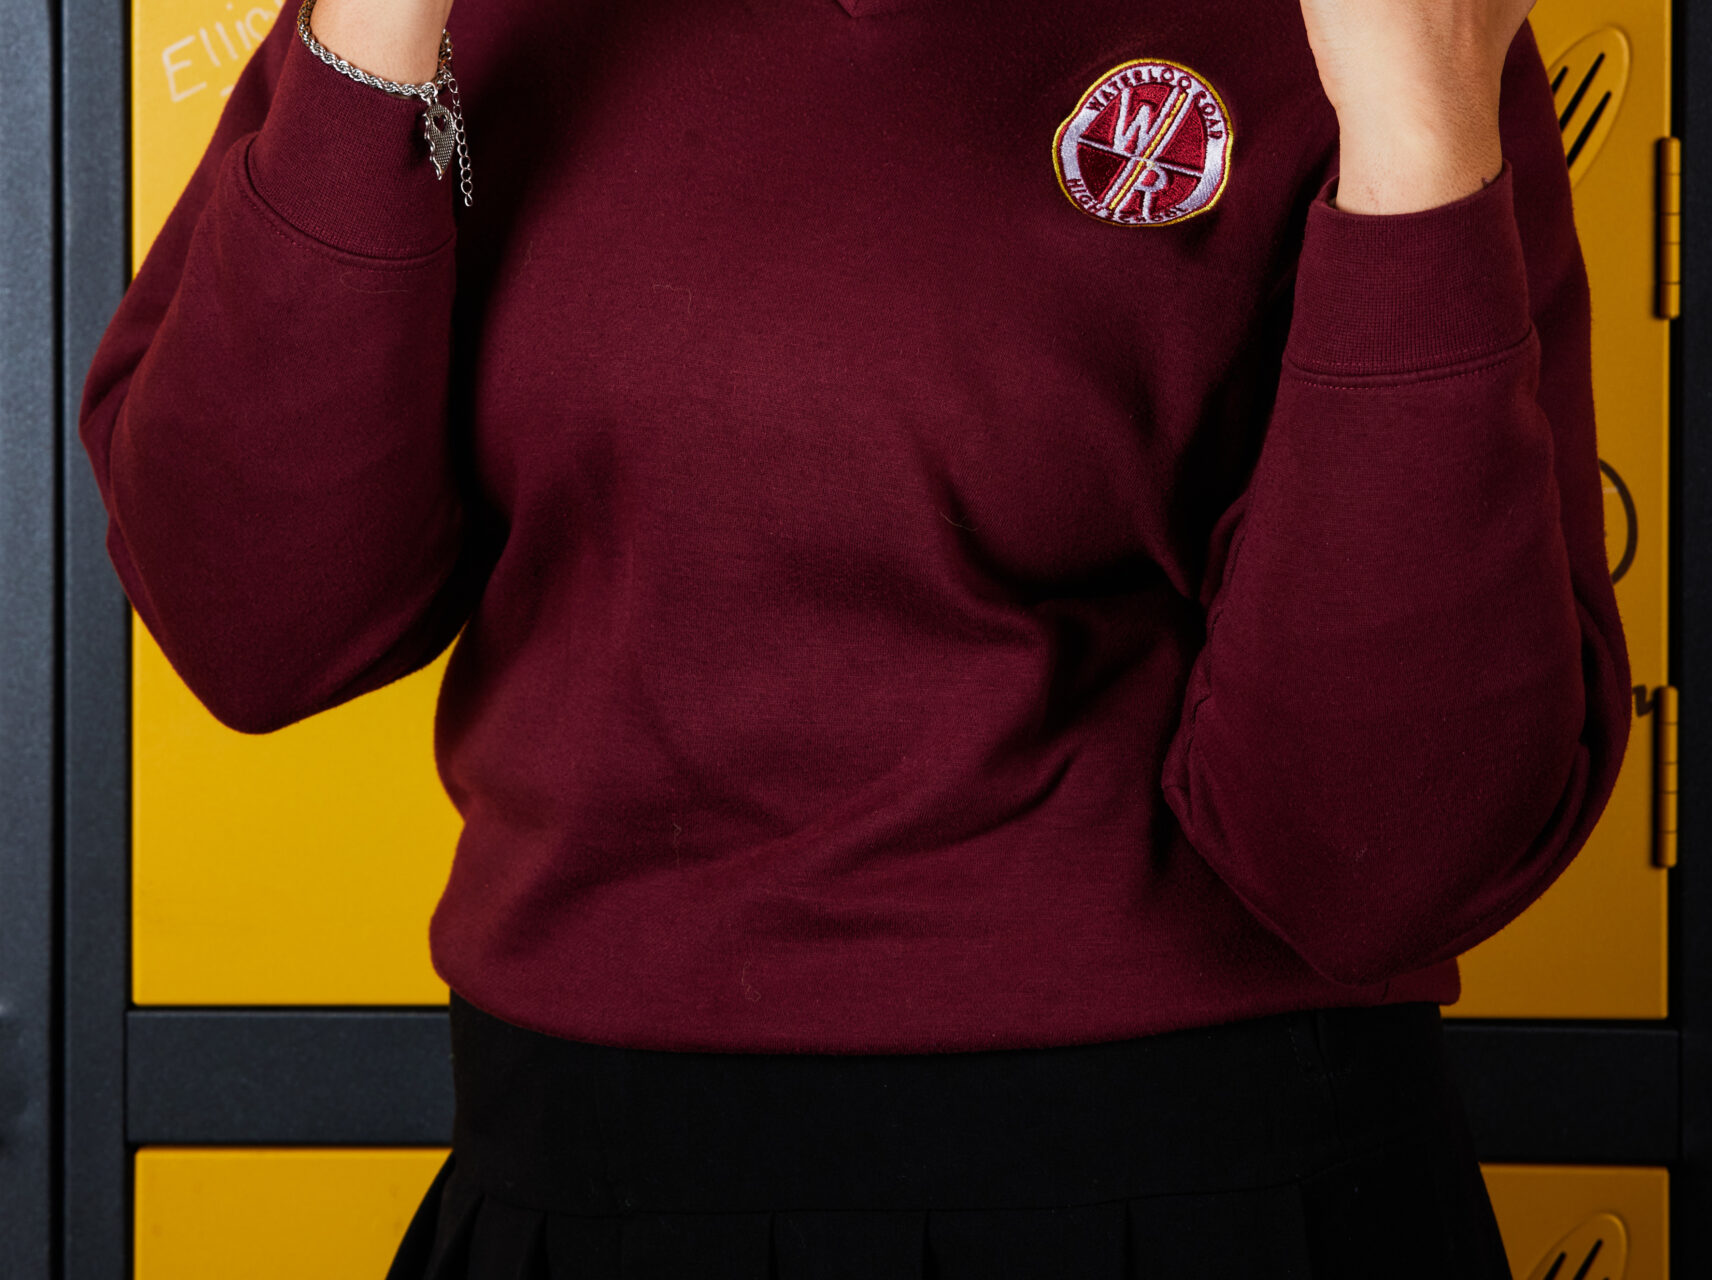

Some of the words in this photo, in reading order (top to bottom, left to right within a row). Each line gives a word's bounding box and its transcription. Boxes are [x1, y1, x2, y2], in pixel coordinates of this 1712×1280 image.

[1086, 68, 1192, 112] WATERLOO
[1193, 89, 1223, 140] ROAD
[1066, 178, 1104, 214] HIGH
